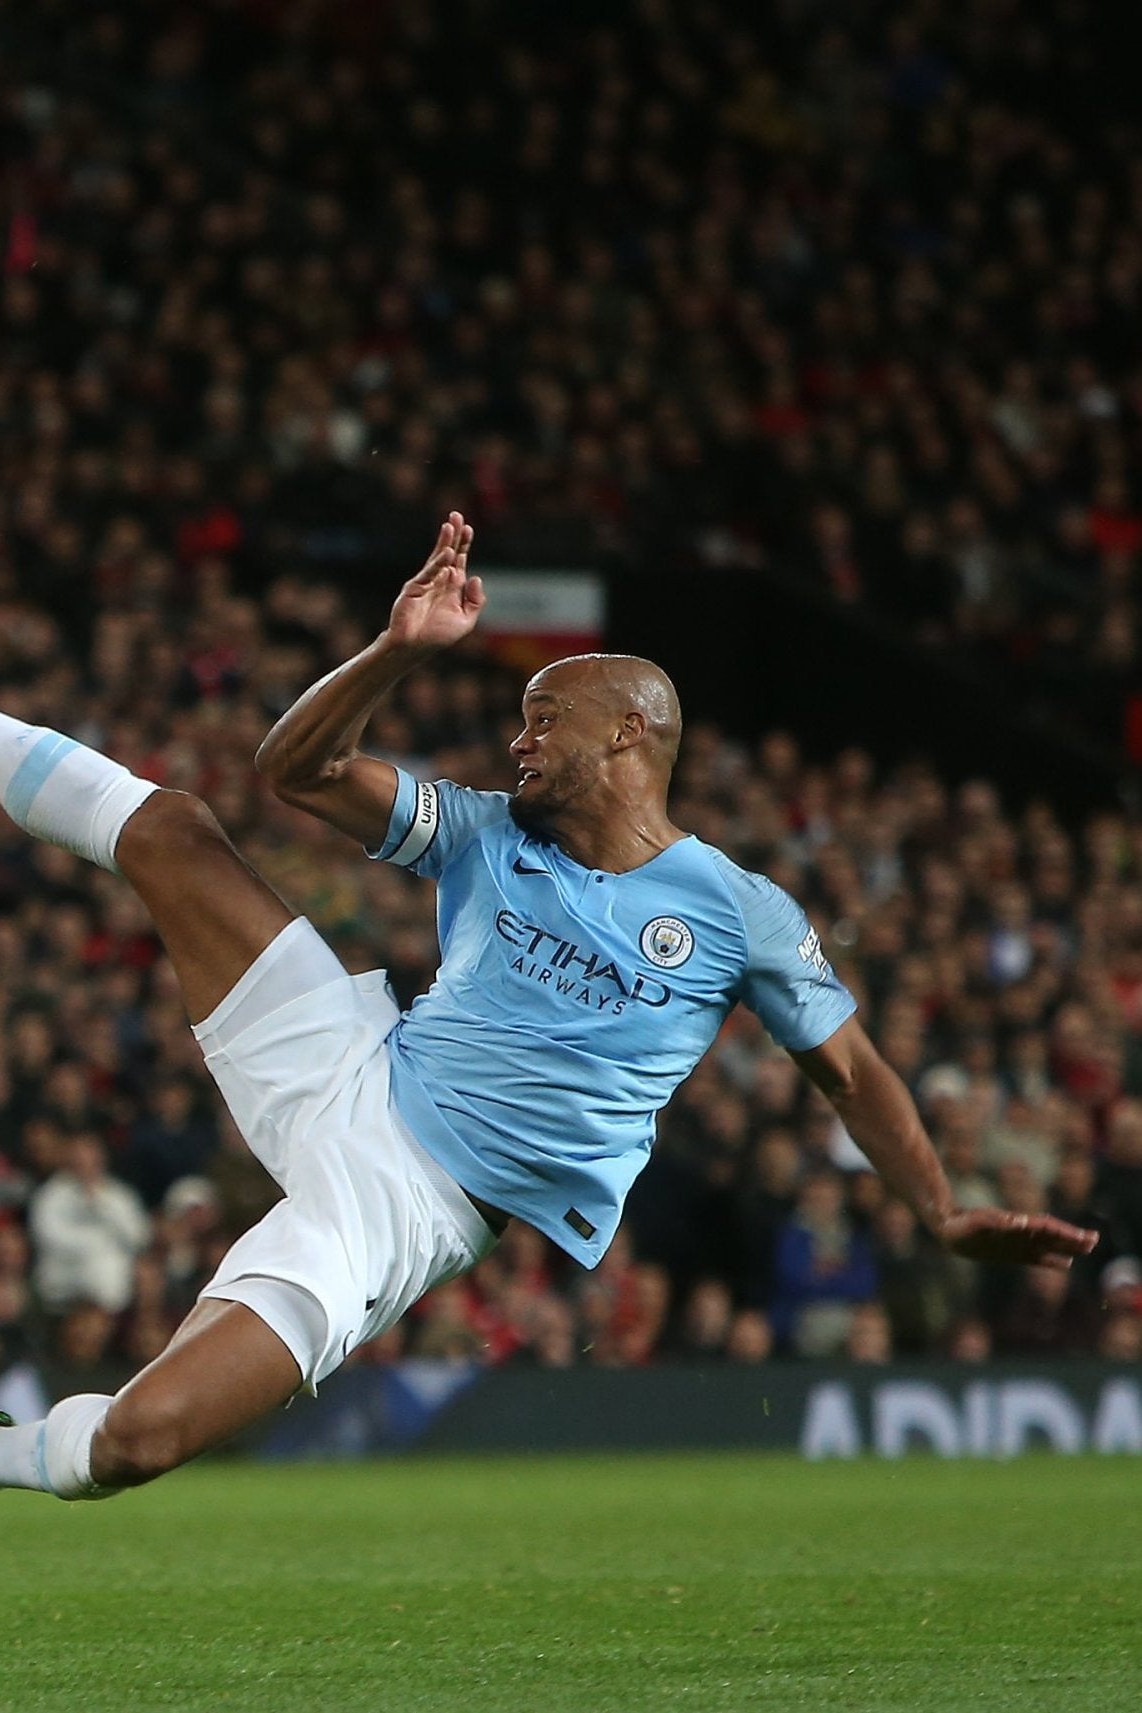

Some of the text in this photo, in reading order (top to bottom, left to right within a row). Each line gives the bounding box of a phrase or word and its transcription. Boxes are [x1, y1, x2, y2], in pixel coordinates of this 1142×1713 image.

[651, 919, 691, 943] MANCHESTER
[496, 909, 672, 1008] ETIHAD
[652, 955, 668, 966] CITY
[511, 956, 627, 1015] AIRWAYS
